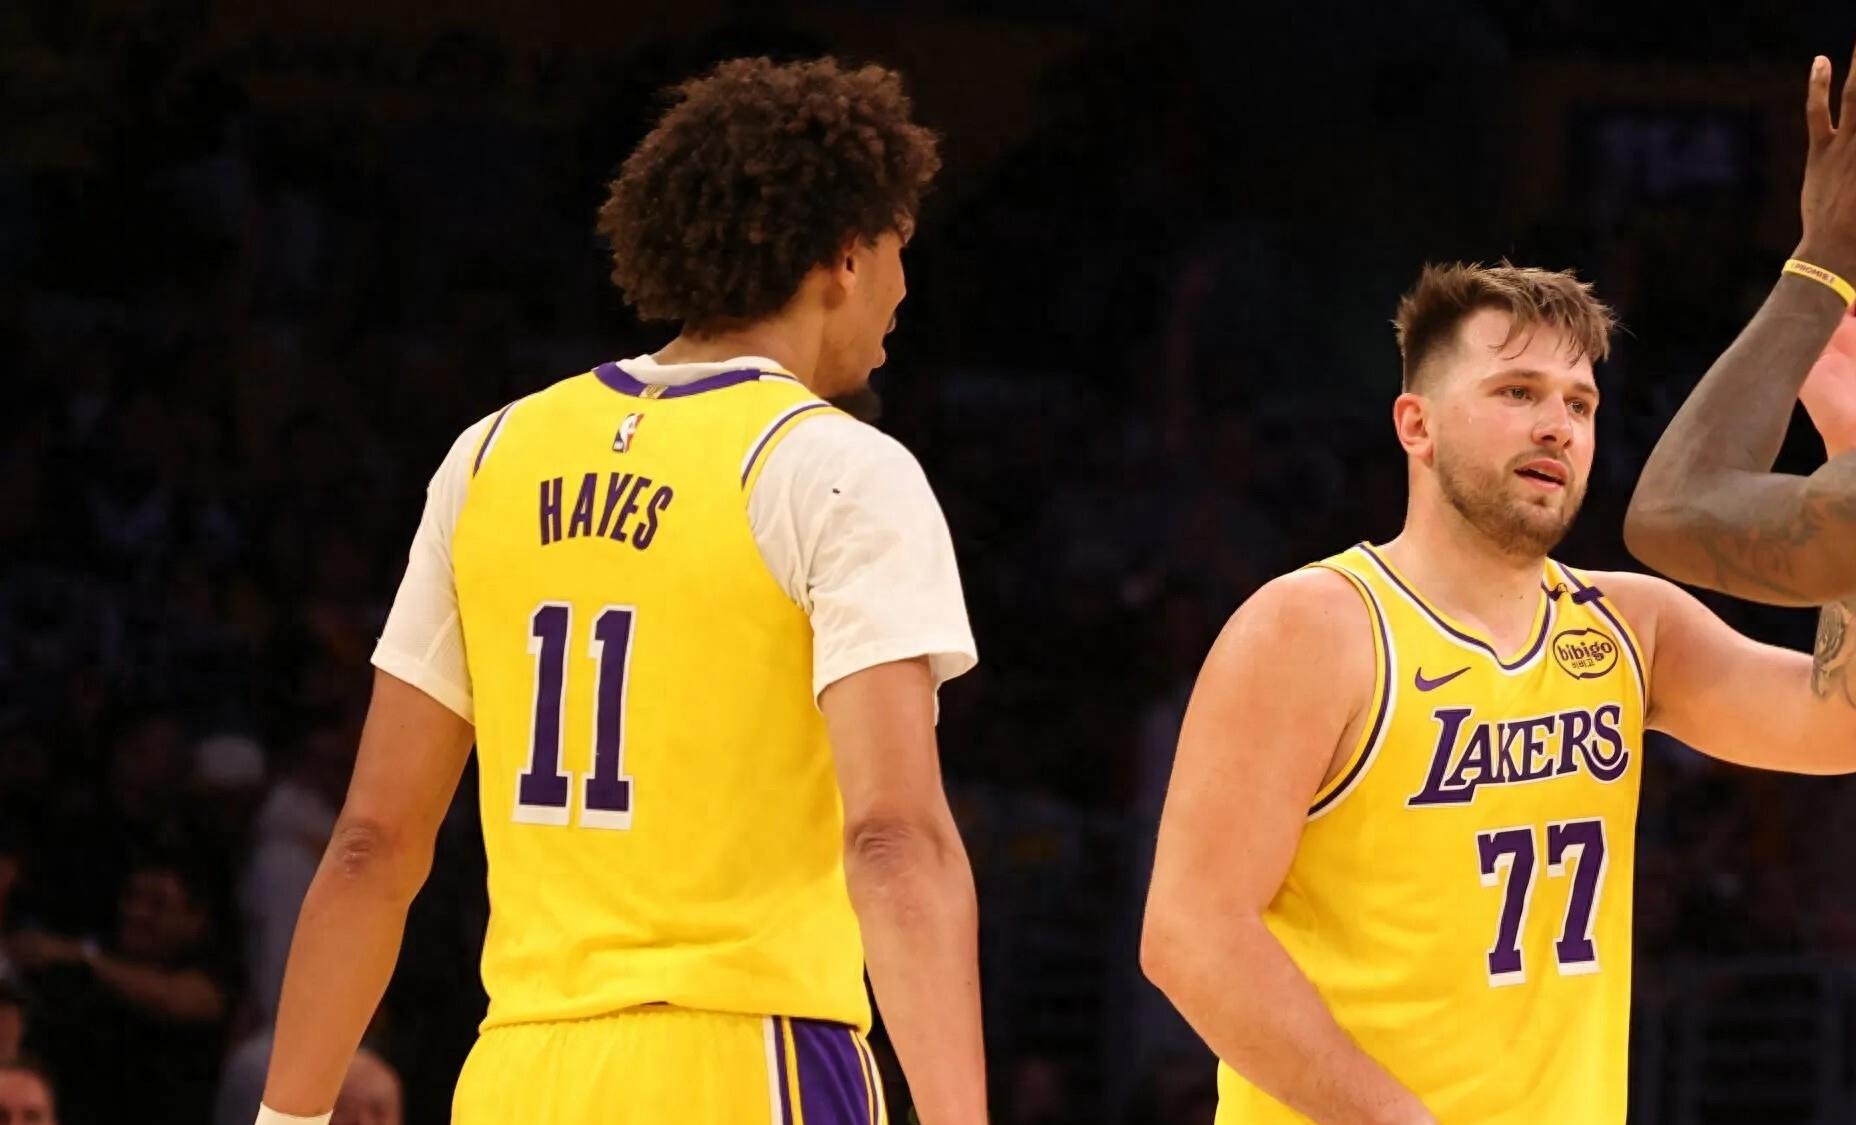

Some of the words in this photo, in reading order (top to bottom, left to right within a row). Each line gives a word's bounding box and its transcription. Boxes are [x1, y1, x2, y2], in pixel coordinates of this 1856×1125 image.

[539, 471, 674, 551] HAYES
[1557, 641, 1613, 662] bibigo
[511, 600, 638, 830] 11
[1404, 702, 1631, 809] LAKERS
[1475, 816, 1610, 989] 77
